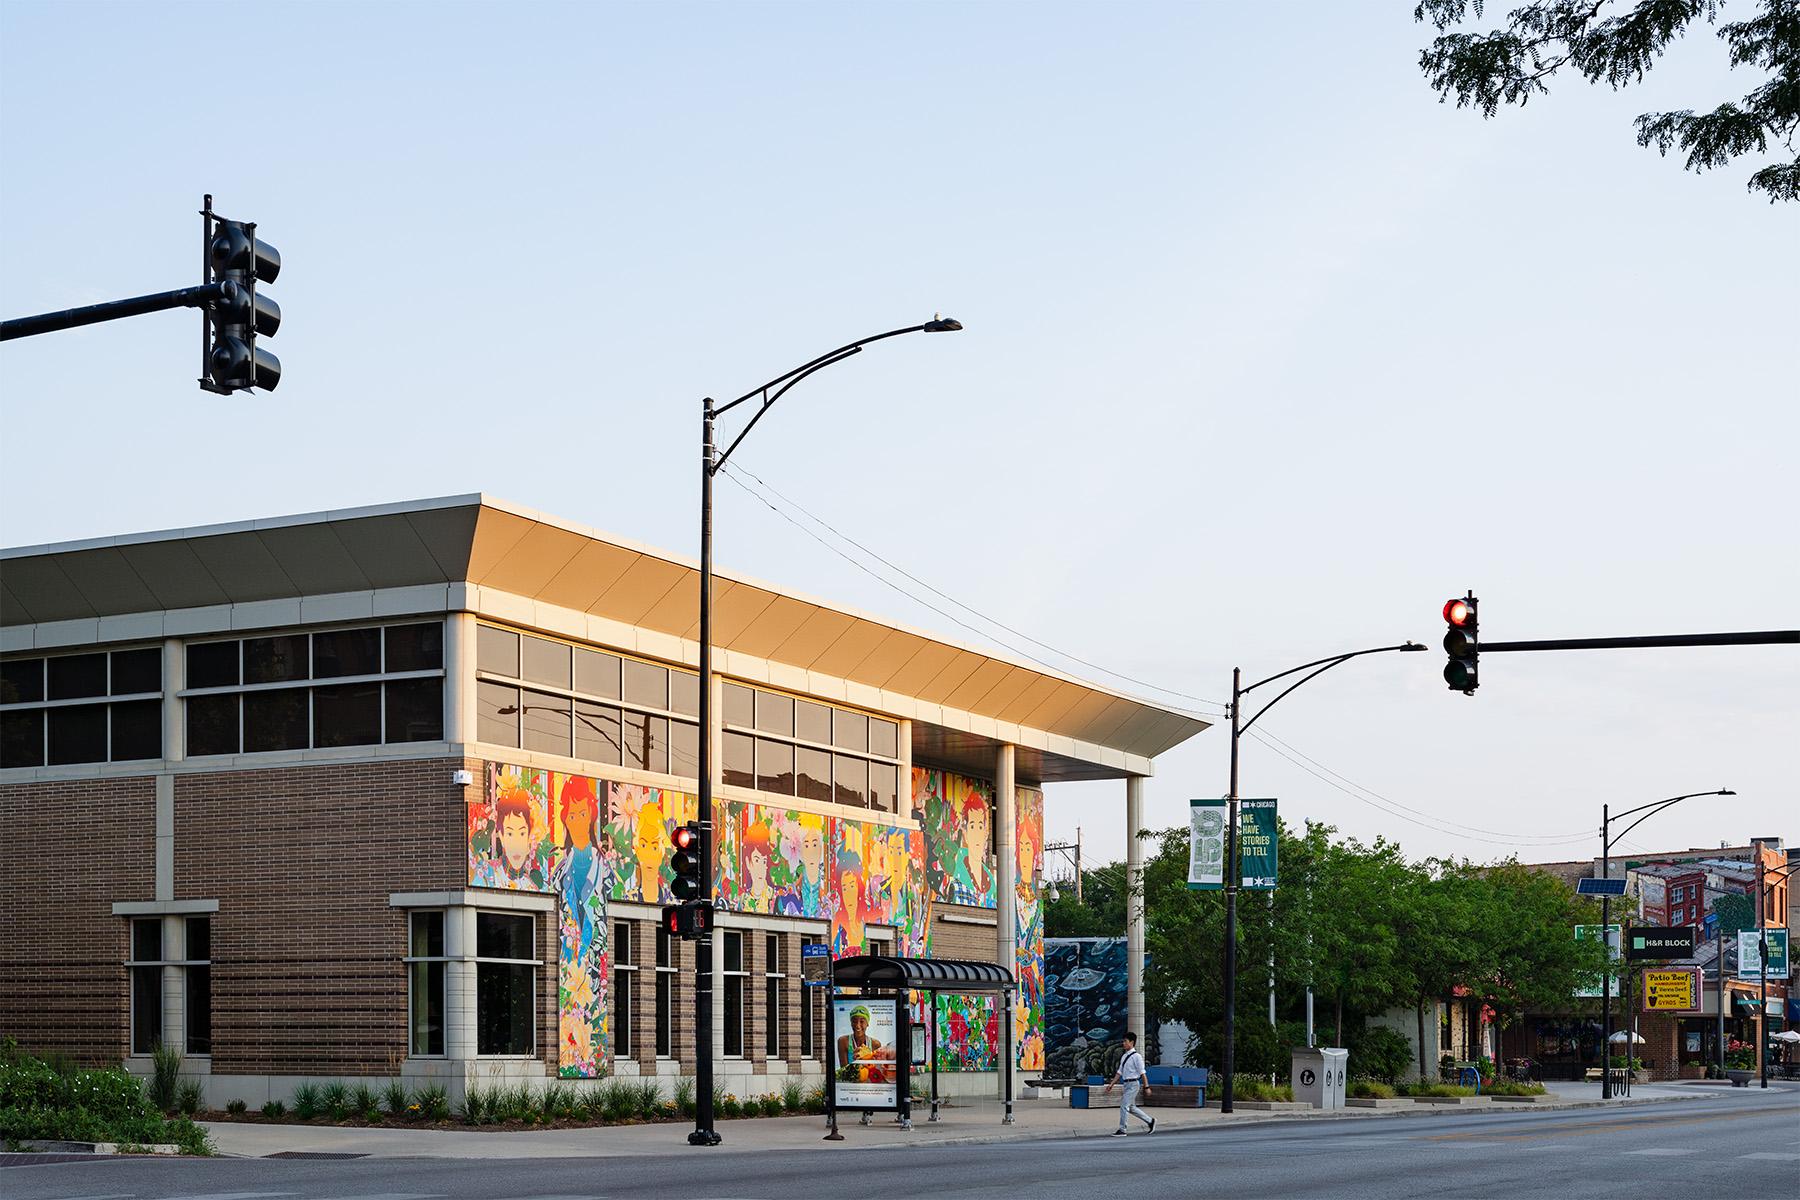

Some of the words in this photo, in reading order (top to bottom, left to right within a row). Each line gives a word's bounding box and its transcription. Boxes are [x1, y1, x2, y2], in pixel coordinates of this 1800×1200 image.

[1242, 814, 1254, 823] WE
[1242, 825, 1259, 834] HAVE
[1242, 836, 1270, 845] STORIES
[1242, 847, 1252, 856] TO
[1253, 847, 1268, 856] TELL
[1671, 973, 1690, 981] Beef
